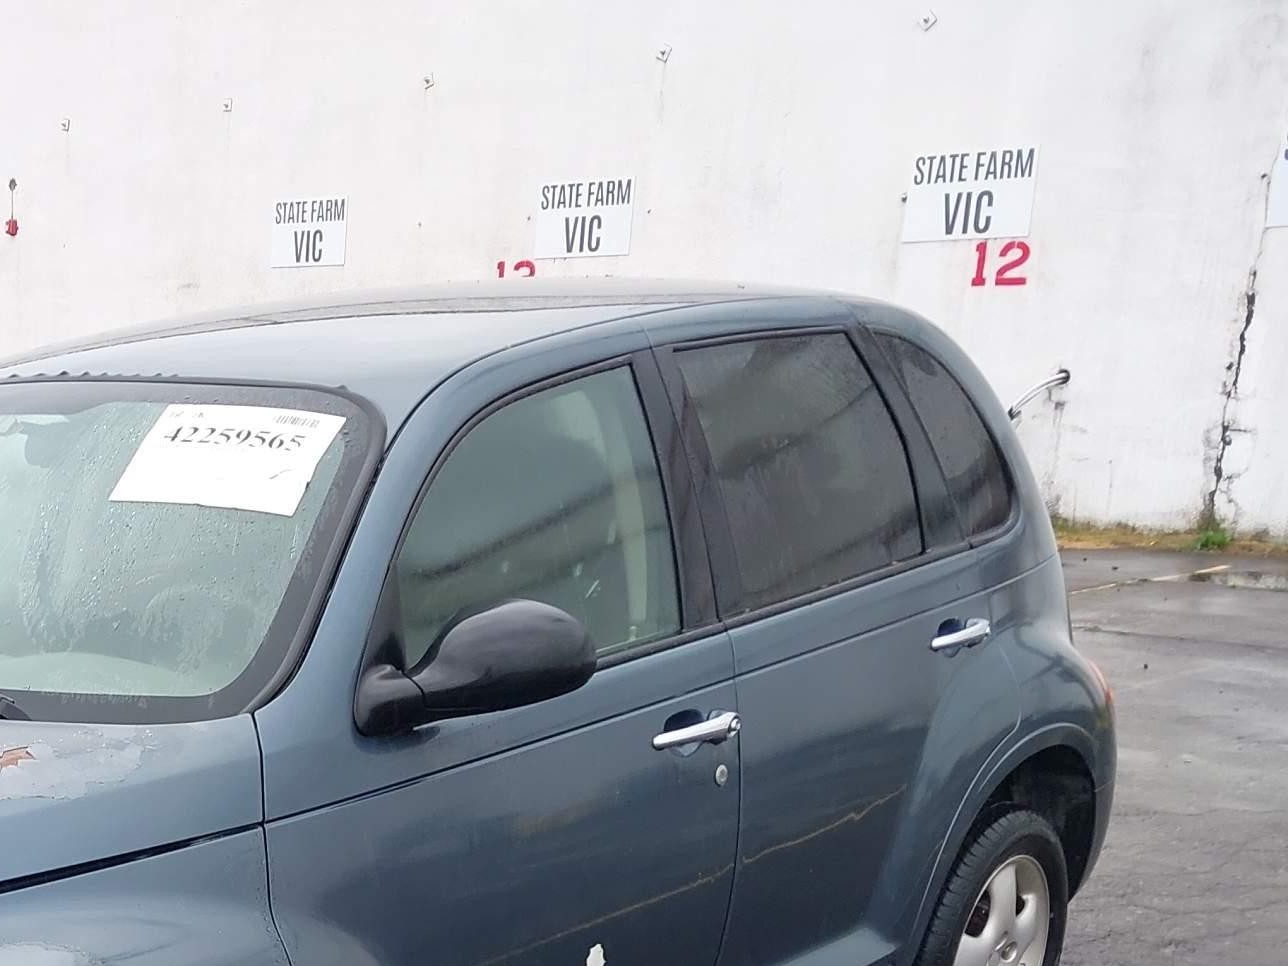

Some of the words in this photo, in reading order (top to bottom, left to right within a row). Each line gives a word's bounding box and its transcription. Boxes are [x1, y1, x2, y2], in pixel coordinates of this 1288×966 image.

[913, 153, 970, 186] STATE
[974, 148, 1035, 181] FARM
[275, 201, 307, 225] STATE
[310, 198, 346, 222] FARM
[541, 183, 584, 210] STATE
[587, 179, 632, 207] FARM
[945, 190, 994, 236] VIC
[294, 230, 323, 263] VIC
[565, 215, 602, 253] VIC
[971, 241, 1031, 286] 12
[164, 425, 306, 451] 42259565
